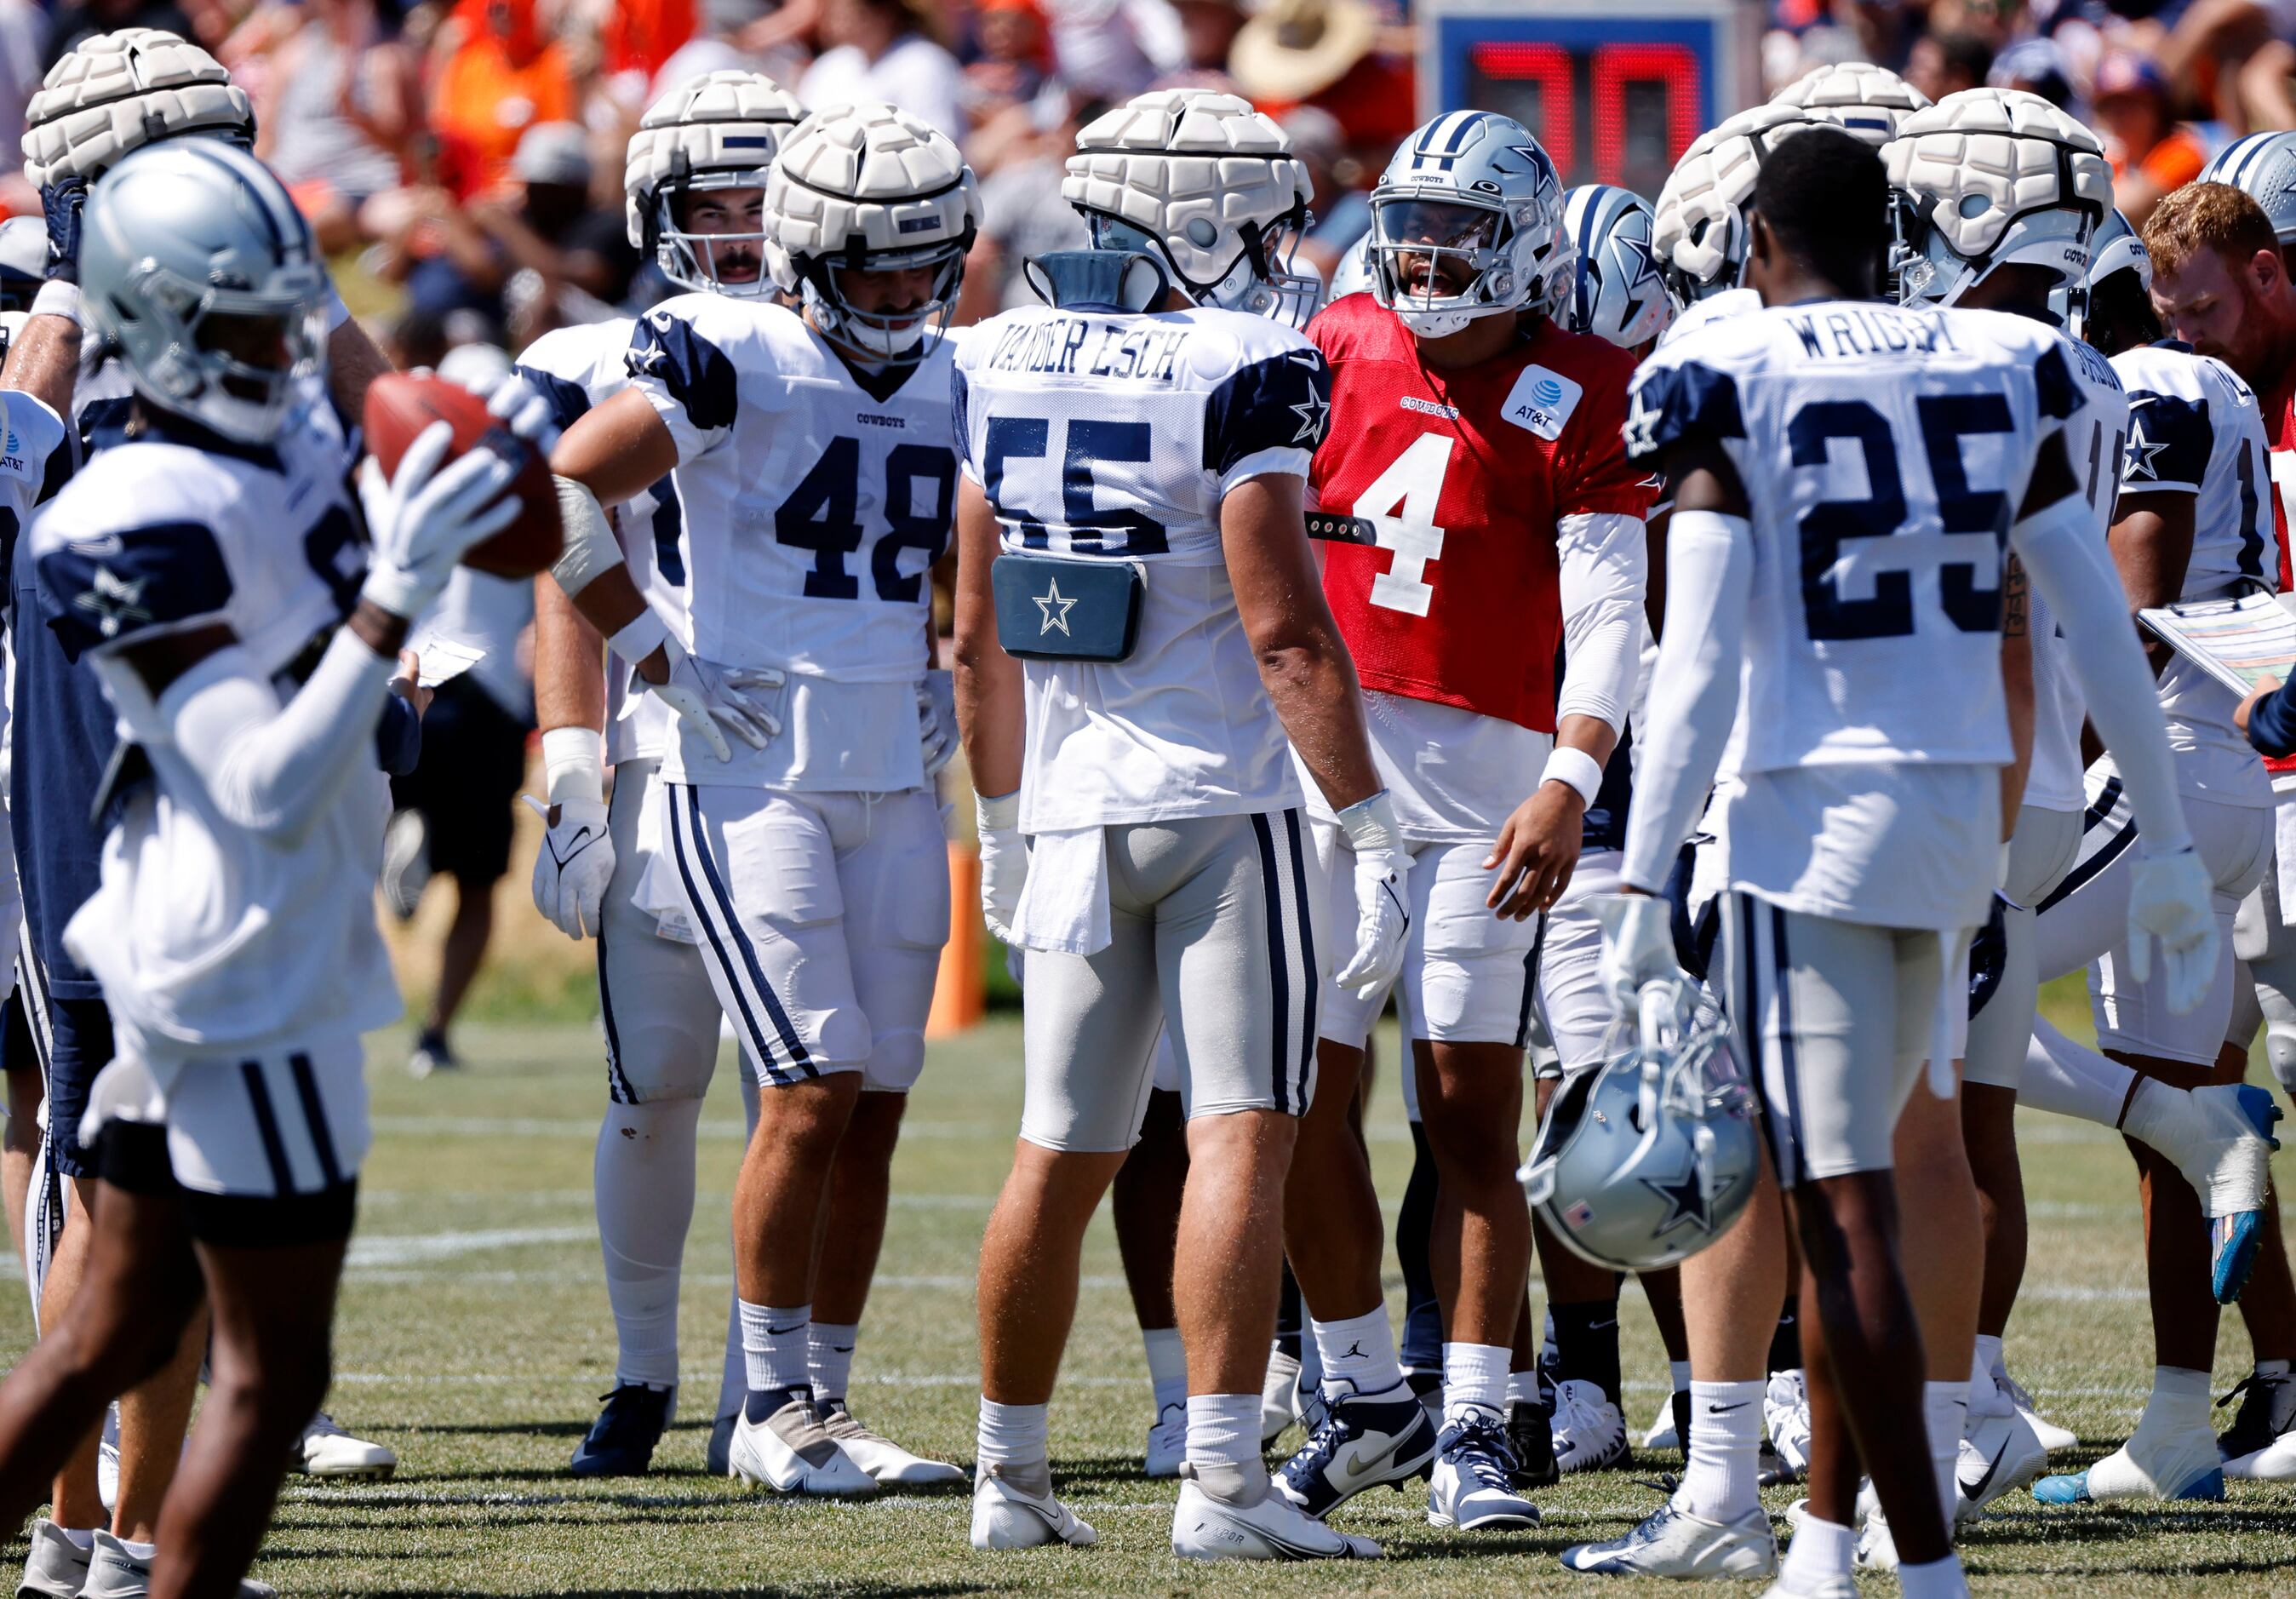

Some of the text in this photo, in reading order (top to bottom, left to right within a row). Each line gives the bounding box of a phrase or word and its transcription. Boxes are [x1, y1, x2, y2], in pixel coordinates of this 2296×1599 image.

[1471, 41, 1701, 189] 70
[1411, 175, 1444, 184] COWBOYS
[989, 318, 1189, 381] VANDER ESCH
[857, 412, 906, 428] COWBOYS
[1401, 397, 1459, 420] COWBOYS
[1515, 405, 1552, 427] AT&T
[0, 456, 24, 472] AT&T
[984, 416, 1171, 556] 55
[775, 435, 957, 603] 48
[1353, 432, 1455, 618] 4
[1788, 393, 2016, 639] 25
